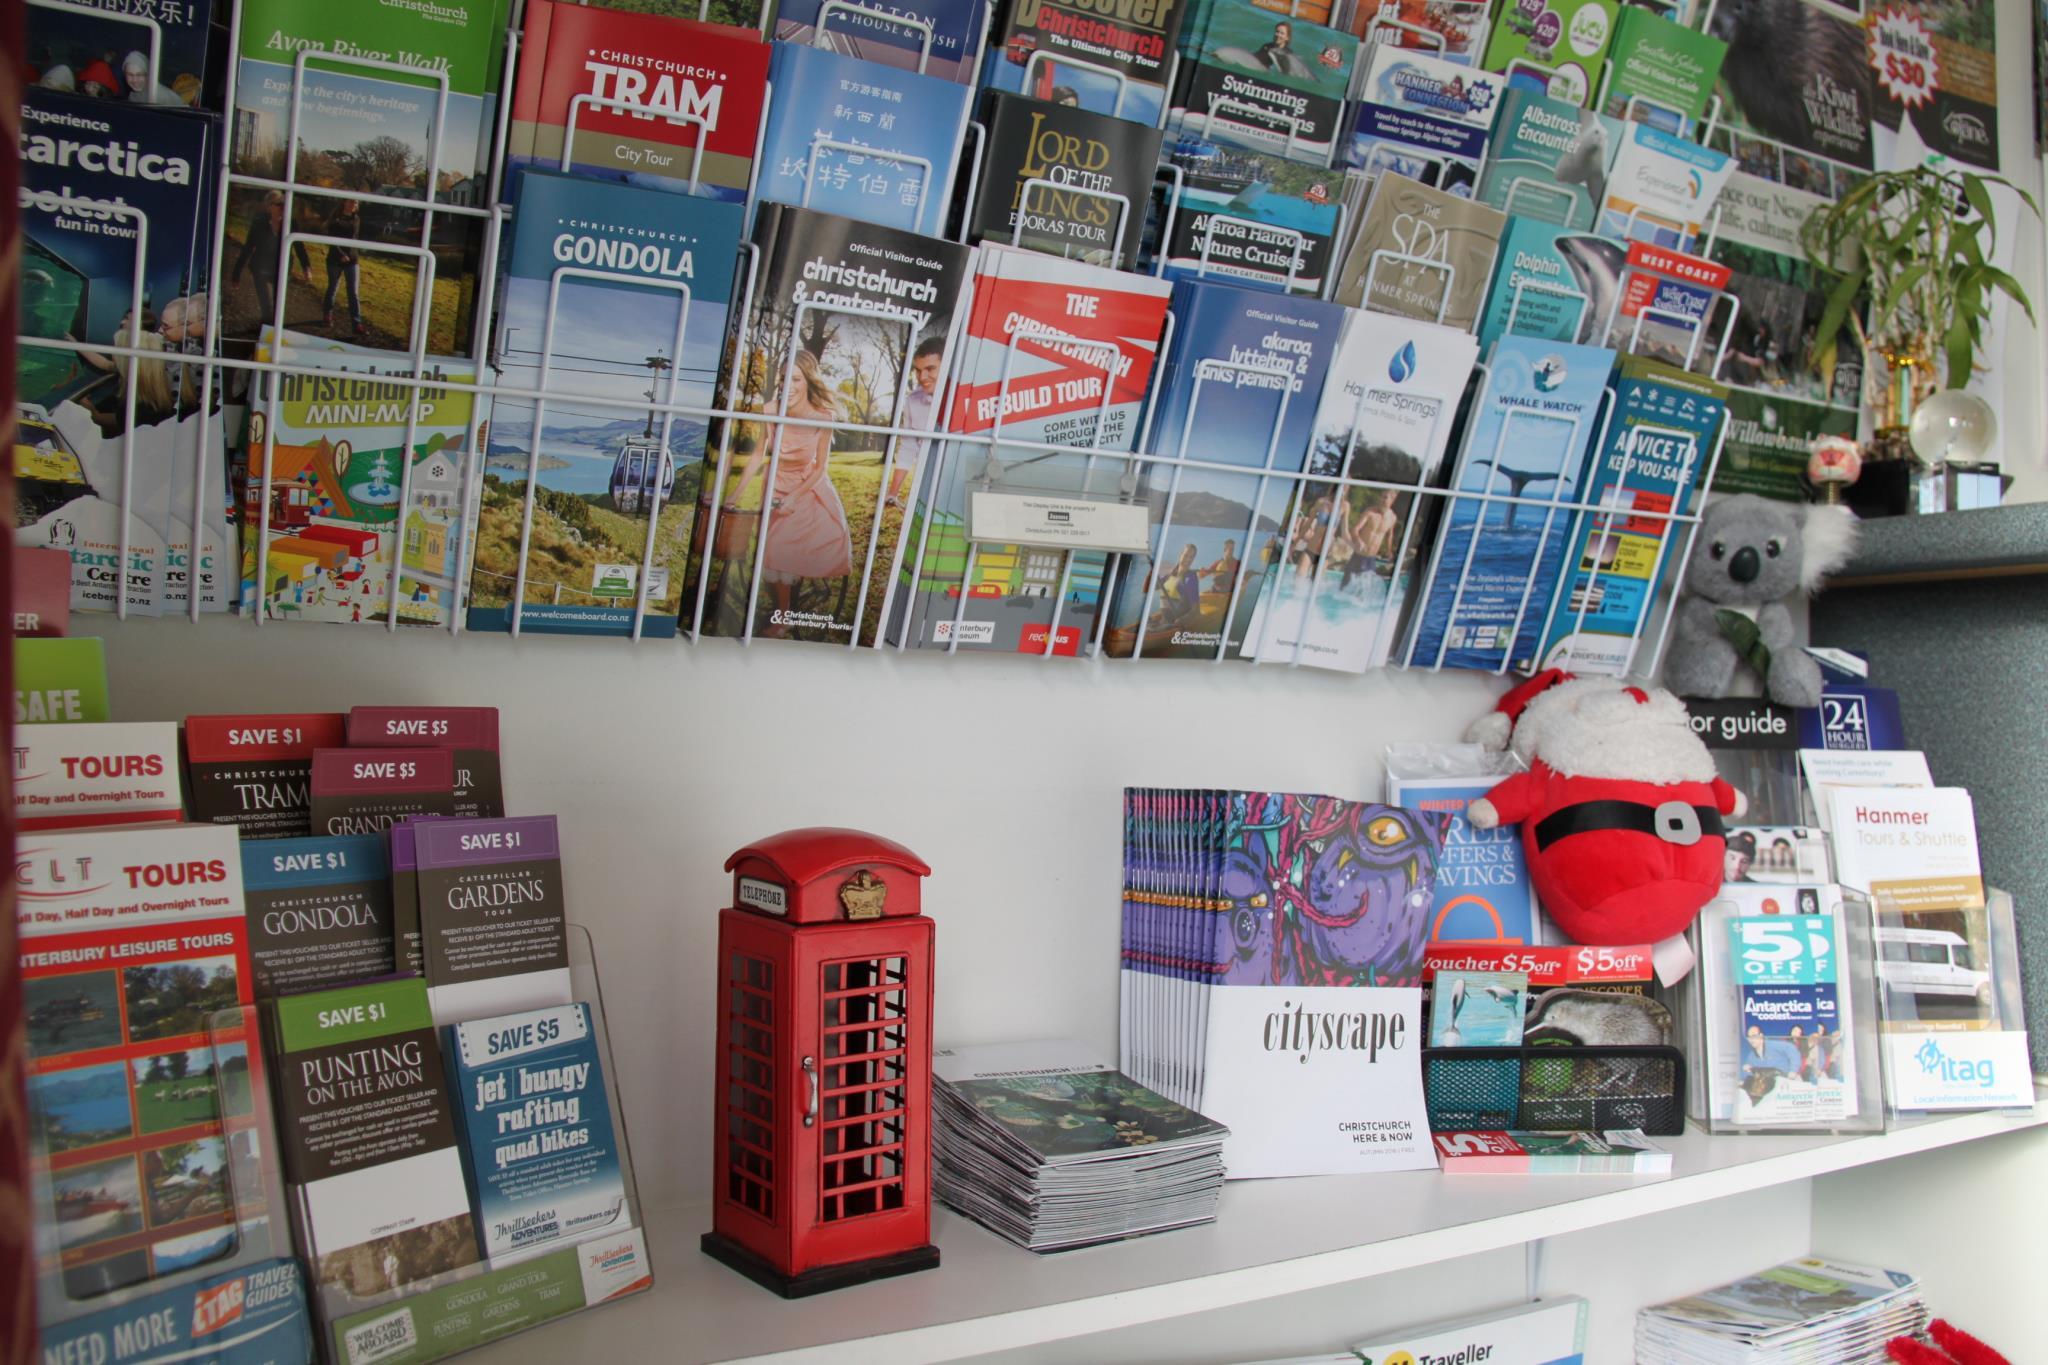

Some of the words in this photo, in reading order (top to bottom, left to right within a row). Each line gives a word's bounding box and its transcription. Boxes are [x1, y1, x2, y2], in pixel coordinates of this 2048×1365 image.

[852, 13, 899, 34] HOUSE
[903, 27, 914, 38] &
[1036, 6, 1165, 58] Christchurch
[266, 29, 325, 52] Avon
[333, 39, 391, 63] River
[1050, 33, 1069, 47] The
[1071, 38, 1112, 57] Ultimate
[1113, 49, 1134, 64] City
[1135, 54, 1160, 69] Tour
[600, 49, 717, 80] CHRISTCHURCH
[1884, 51, 1925, 89] $30
[313, 83, 333, 99] the
[1221, 74, 1308, 116] Swimming
[1395, 72, 1442, 93] HANMER
[1815, 73, 1858, 105] Kiwi
[584, 61, 724, 132] TRAM
[20, 105, 110, 132] Experience
[1523, 104, 1582, 135] Albatross
[1803, 97, 1867, 141] Wildlife
[1018, 111, 1110, 178] LORD
[1516, 123, 1581, 154] Encounter
[615, 145, 641, 166] City
[644, 149, 674, 167] Tour
[1050, 165, 1077, 186] OF
[1079, 170, 1113, 194] THE
[1423, 203, 1442, 219] THE
[55, 215, 81, 231] fun
[85, 219, 100, 235] in
[569, 219, 687, 243] CHRISTCHURCH
[1067, 222, 1107, 242] TOUR
[553, 233, 695, 279] GONDOLA
[849, 242, 882, 257] Official
[884, 250, 914, 264] Visitor
[915, 256, 944, 271] Guide
[1382, 213, 1446, 282] SPA
[1514, 251, 1562, 277] Dolphin
[1640, 252, 1674, 271] WEST
[1675, 263, 1719, 284] COAST
[792, 279, 808, 304] &
[802, 255, 939, 304] christchurch
[1066, 293, 1100, 318] THE
[1246, 308, 1274, 321] Official
[1275, 313, 1298, 326] Visitor
[1298, 318, 1320, 330] Guide
[1295, 355, 1309, 375] &
[977, 385, 1053, 421] REBUILD
[1057, 376, 1103, 404] TOUR
[1391, 392, 1437, 419] Springs
[1499, 393, 1540, 409] WHALE
[1542, 402, 1583, 414] WATCH
[305, 402, 436, 425] MINI-MAP
[1043, 417, 1077, 434] COME
[1110, 410, 1126, 420] US
[1099, 433, 1123, 445] CITY
[1102, 422, 1125, 433] THE
[1637, 458, 1662, 479] YOU
[782, 617, 827, 629] Canterbury
[783, 610, 835, 622] Christchurch
[386, 720, 428, 736] SAVE
[431, 719, 449, 737] $5
[1721, 708, 1787, 739] guide
[1824, 700, 1864, 732] 24
[228, 729, 279, 746] SAVE
[282, 728, 302, 745] $1
[1827, 731, 1866, 743] HOUR
[61, 754, 164, 780] TOURS
[353, 762, 396, 780] SAVE
[399, 762, 417, 780] $5
[29, 795, 51, 806] Day
[54, 794, 76, 804] and
[78, 790, 132, 804] Overnight
[134, 789, 165, 799] Tours
[232, 783, 312, 811] TRAM
[348, 804, 424, 813] CHRISTCHURCH
[327, 814, 392, 837] GRAND
[1856, 806, 1929, 825] Hanmer
[460, 833, 502, 851] SAVE
[505, 831, 521, 849] $1
[1857, 829, 1894, 846] Tours
[1899, 830, 1910, 846] &
[1914, 830, 1968, 847] Shuttle
[273, 853, 323, 872] SAVE
[326, 851, 347, 870] $1
[1501, 844, 1516, 862] &
[122, 859, 227, 889] TOURS
[458, 870, 532, 883] CATERPILLAR
[271, 893, 364, 908] CHRISTCHURCH
[447, 879, 544, 910] GARDENS
[742, 884, 782, 906] TELEPHONE
[65, 907, 89, 920] Half
[92, 905, 115, 918] Day
[117, 902, 139, 914] and
[141, 899, 197, 912] Overnight
[198, 896, 230, 908] Tours
[263, 903, 379, 936] GONDOLA
[484, 908, 513, 917] TOUR
[110, 938, 178, 958] LEISURE
[182, 931, 235, 950] TOURS
[1744, 961, 1802, 975] OFF
[318, 1005, 366, 1029] SAVE
[368, 1002, 387, 1022] $1
[1744, 997, 1813, 1013] Antarctica
[487, 1024, 534, 1056] SAVE
[536, 1017, 561, 1045] $5
[1263, 1000, 1406, 1065] cityscape
[301, 1041, 423, 1087] PUNTING
[974, 1067, 1071, 1079] CHRISTCHURCH
[1940, 1056, 1995, 1087] itag
[306, 1083, 336, 1106] ON
[338, 1076, 375, 1099] THE
[377, 1066, 424, 1092] AVON
[474, 1071, 508, 1112] jet
[518, 1061, 591, 1097] bungy
[496, 1096, 580, 1134] rafting
[1338, 1120, 1412, 1132] CHRISTCHURCH
[495, 1134, 541, 1169] quad
[541, 1127, 590, 1154] bikes
[1352, 1133, 1378, 1144] HERE
[1380, 1133, 1388, 1142] &
[1388, 1131, 1414, 1142] NOW
[510, 1220, 560, 1242] ADVENTURES
[247, 1263, 297, 1291] TRAVEL
[245, 1278, 295, 1309] GUIDES
[113, 1307, 178, 1360] MORE
[352, 1314, 406, 1343] WELCOME
[356, 1326, 408, 1355] ABOARD
[1420, 1343, 1494, 1365] Traveller
